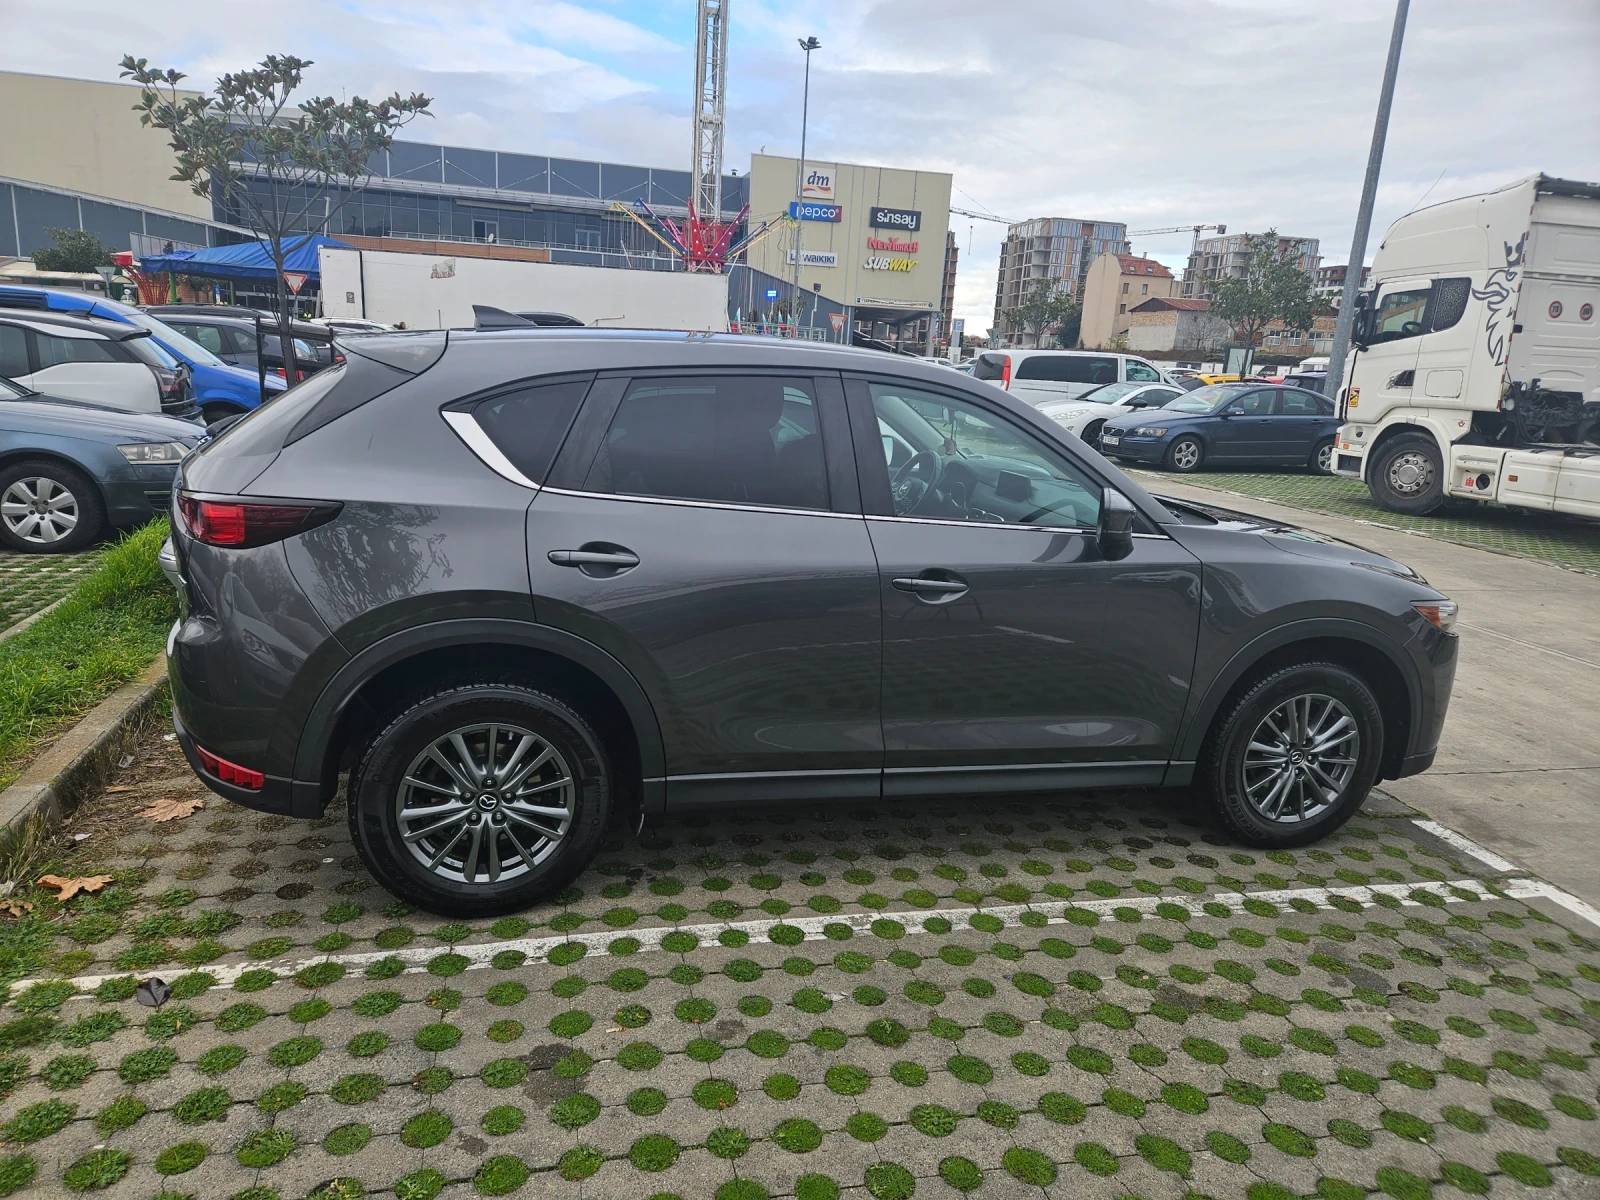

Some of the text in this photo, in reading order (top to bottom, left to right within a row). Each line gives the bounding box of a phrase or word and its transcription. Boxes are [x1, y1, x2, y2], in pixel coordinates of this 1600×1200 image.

[807, 171, 829, 186] dm
[796, 206, 836, 218] pepco
[876, 210, 916, 229] sinsay
[863, 257, 919, 271] SUBWAY
